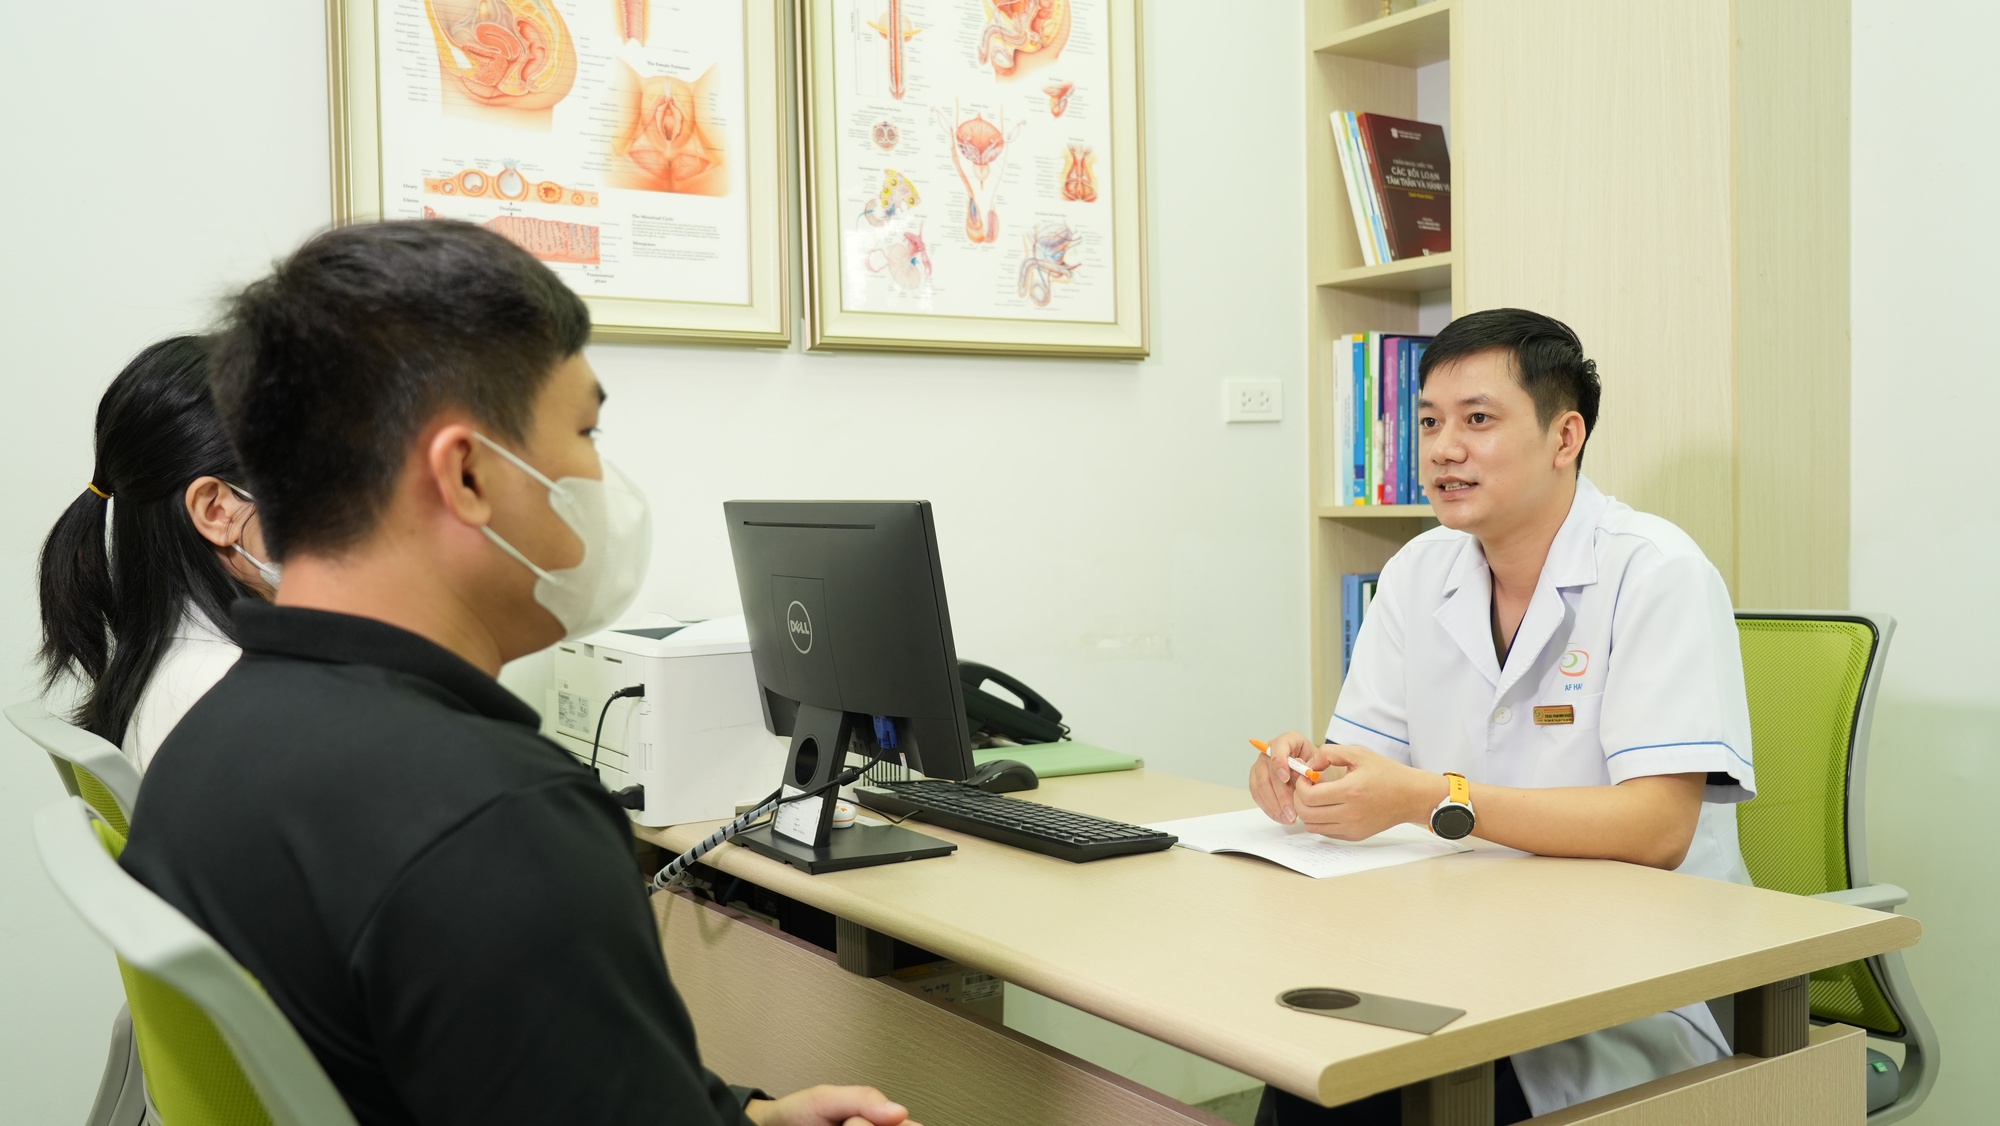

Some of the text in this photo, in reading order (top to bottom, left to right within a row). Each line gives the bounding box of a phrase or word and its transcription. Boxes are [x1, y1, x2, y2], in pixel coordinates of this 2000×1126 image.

[1385, 175, 1400, 186] TÂM
[1391, 166, 1407, 177] CÁC
[1420, 170, 1440, 181] LOẠN
[790, 619, 810, 635] DELL
